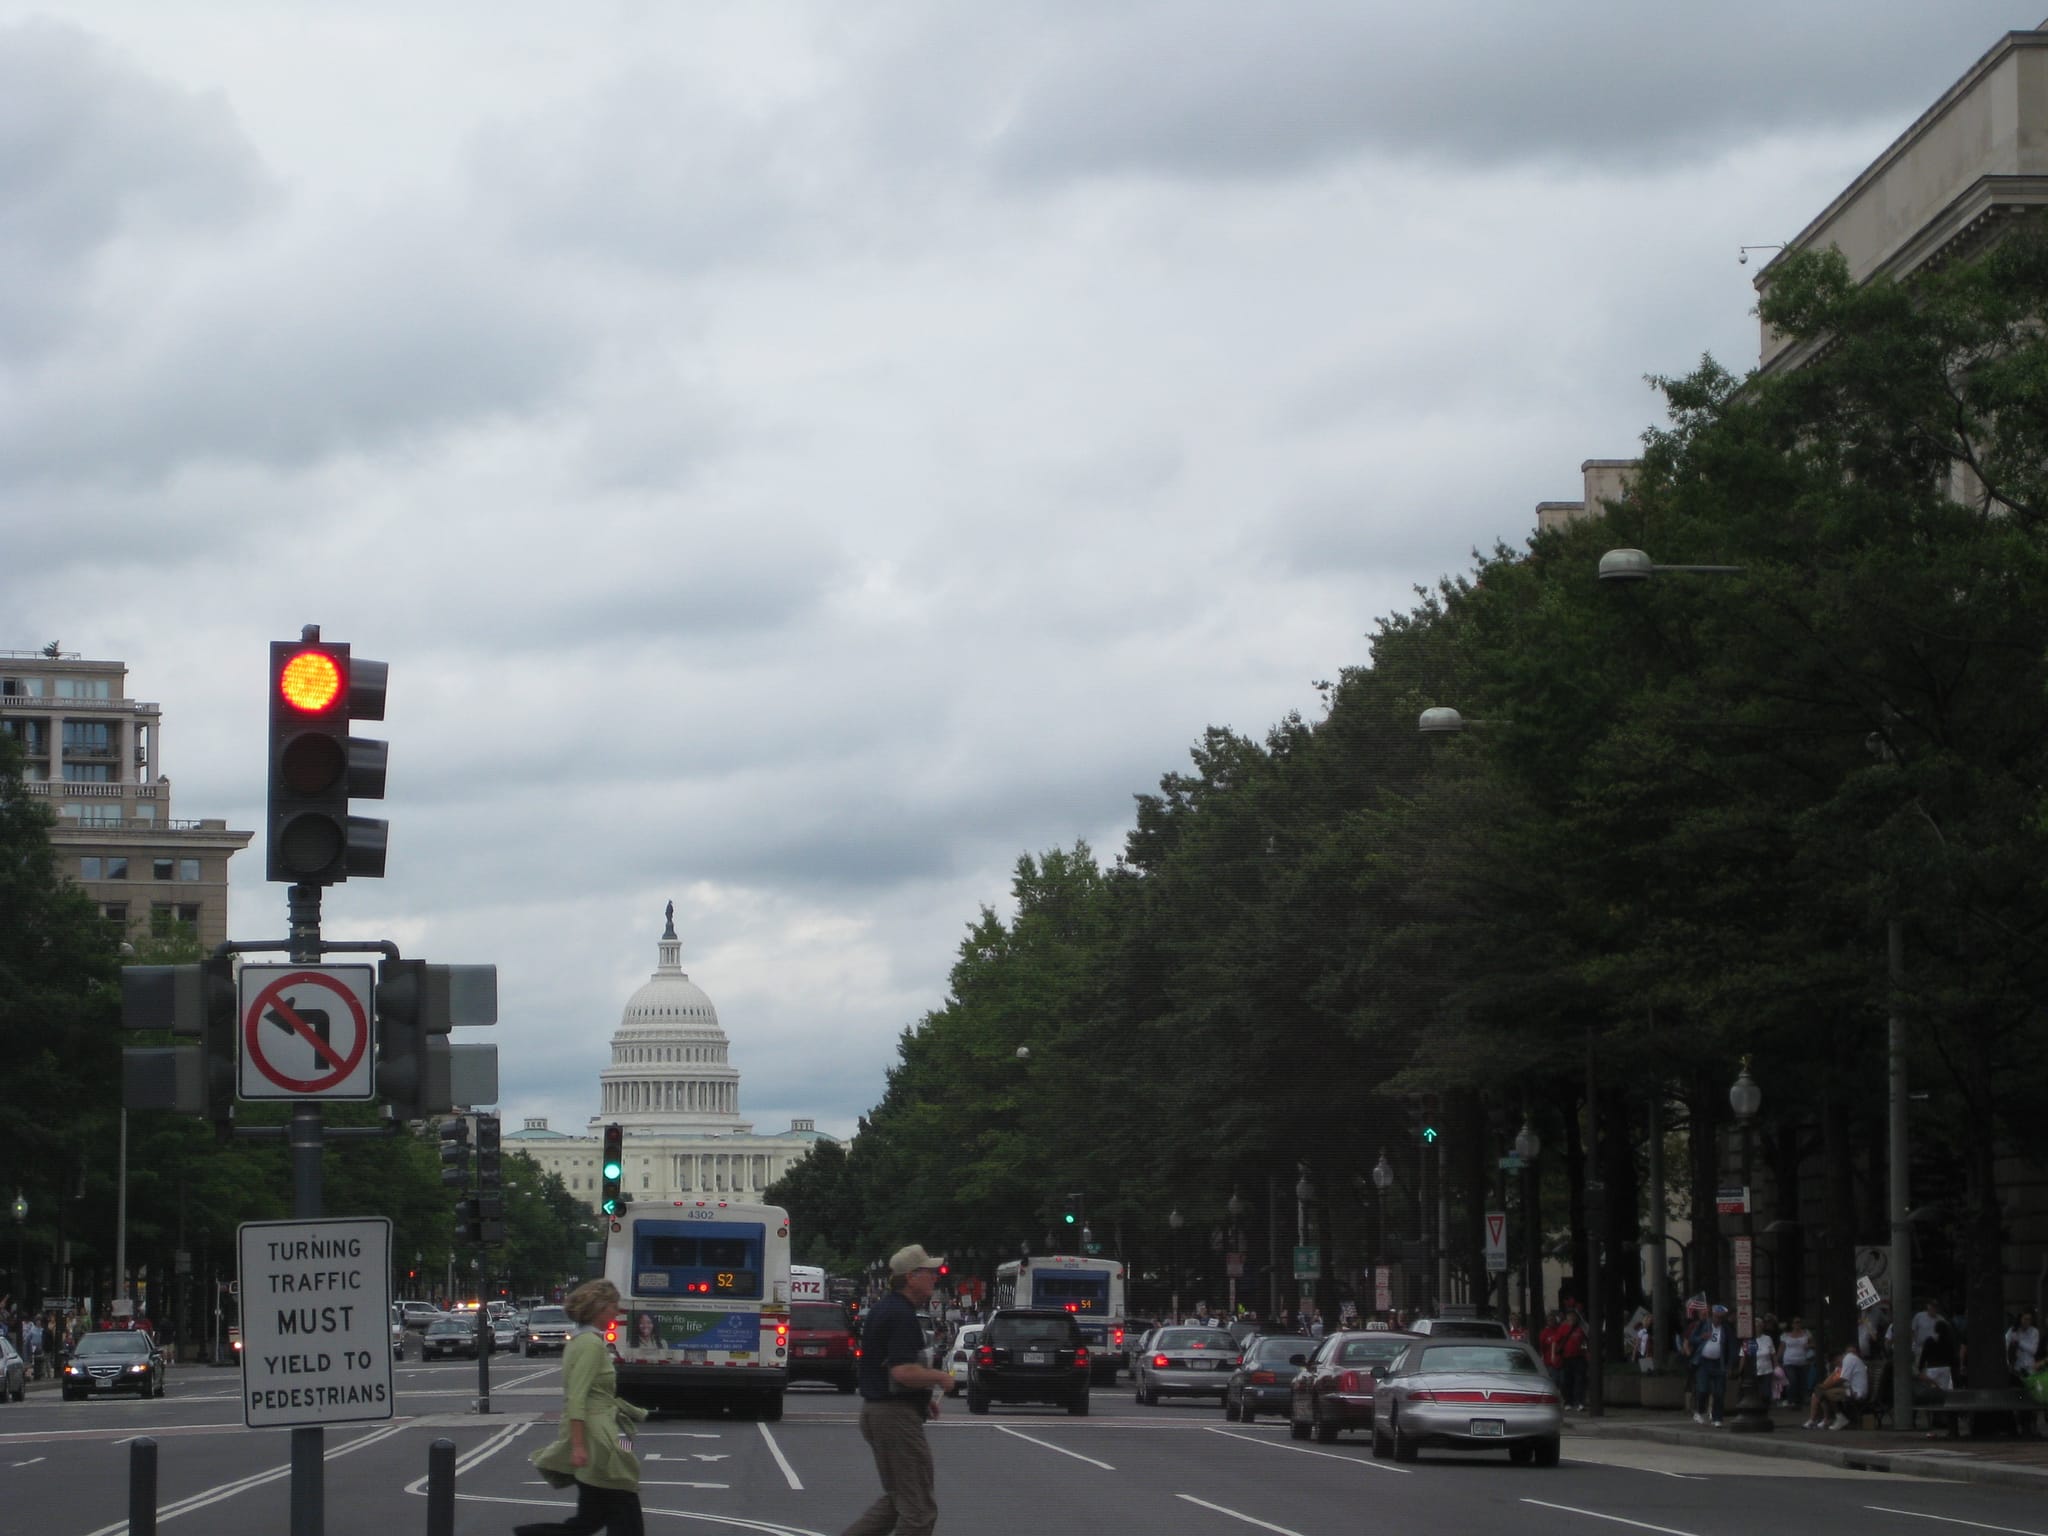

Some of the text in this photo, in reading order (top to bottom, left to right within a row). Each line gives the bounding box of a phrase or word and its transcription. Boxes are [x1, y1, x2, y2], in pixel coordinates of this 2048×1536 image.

[688, 1210, 714, 1219] 4302
[267, 1239, 361, 1261] TURNING
[268, 1271, 361, 1293] TRAFFIC
[717, 1274, 734, 1287] S2
[278, 1306, 353, 1335] MUST
[672, 1323, 685, 1332] my
[673, 1315, 685, 1324] fits
[264, 1351, 372, 1375] YIELD TO
[252, 1384, 386, 1410] PEDESTRIANS
